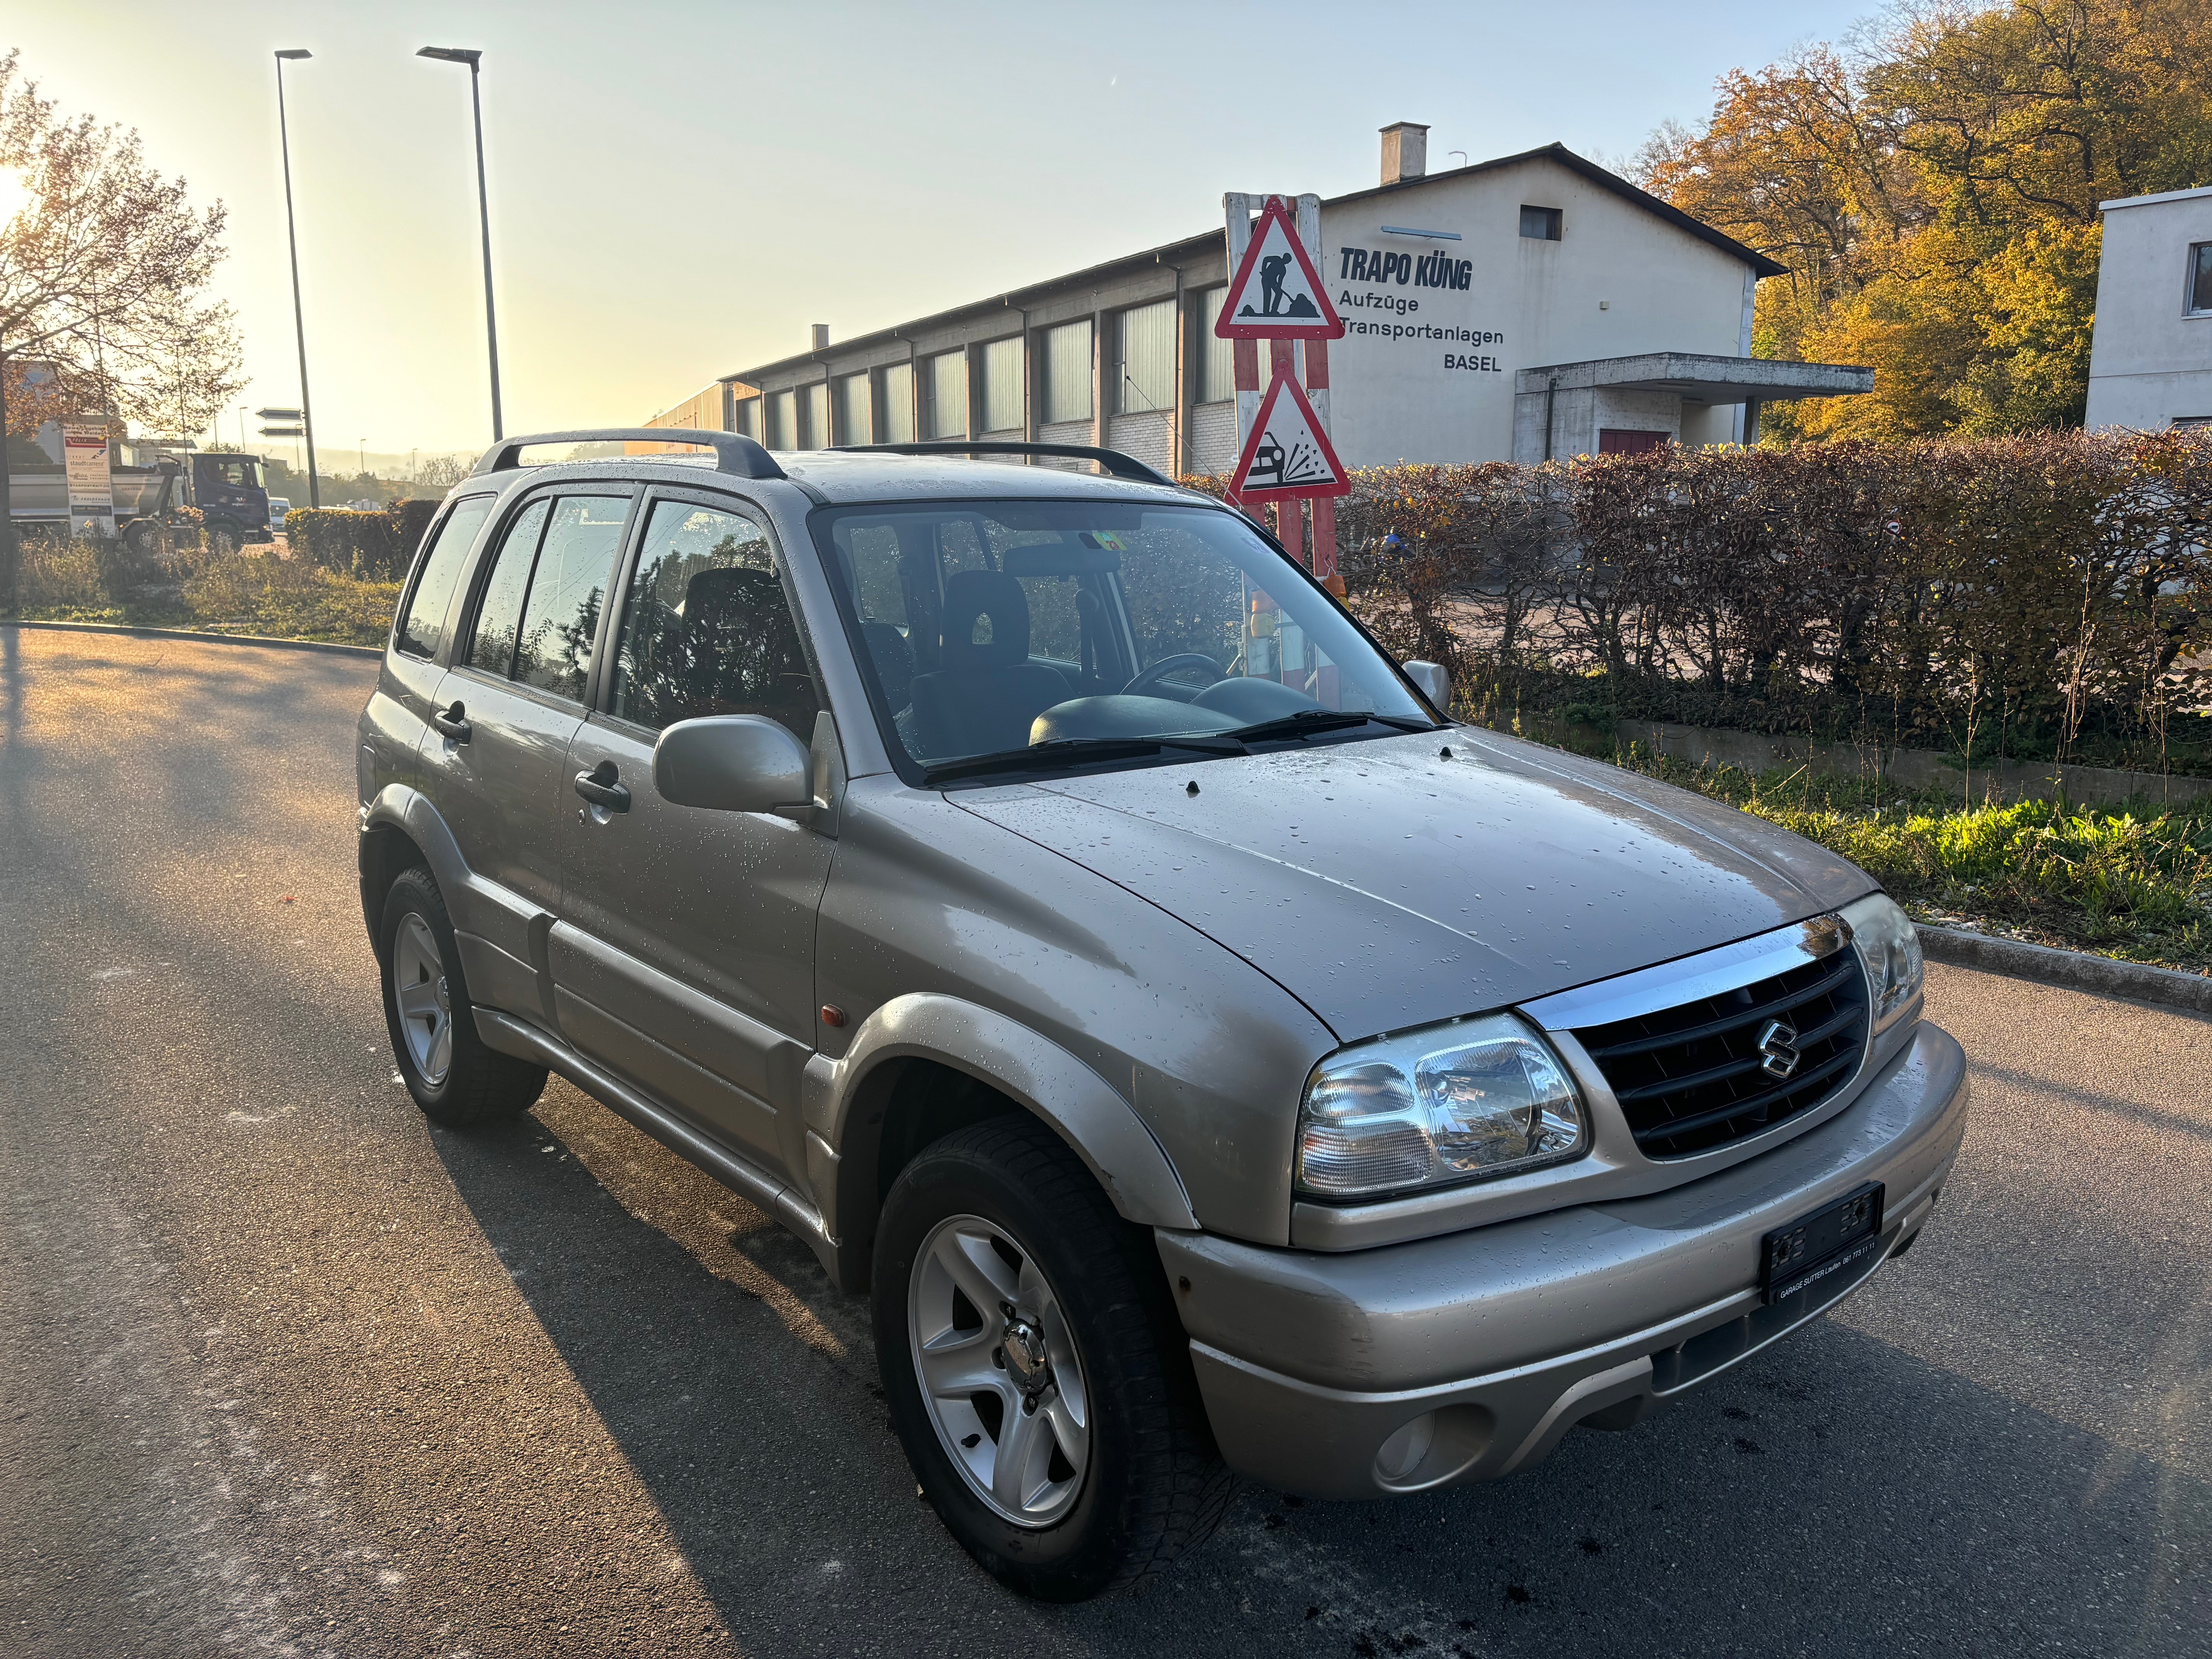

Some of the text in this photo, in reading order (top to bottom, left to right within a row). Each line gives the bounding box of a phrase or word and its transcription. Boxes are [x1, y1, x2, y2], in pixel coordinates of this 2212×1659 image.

[1341, 247, 1472, 290] TRAPO KÜNG
[1339, 290, 1418, 315] Aufzüge
[1339, 317, 1503, 347] Transportanlagen
[1444, 354, 1501, 372] BASEL
[1780, 1281, 1803, 1298] GARAGE
[1803, 1269, 1824, 1286] SUTTER
[1825, 1262, 1841, 1274] Laufen
[1843, 1254, 1851, 1264] 061
[1863, 1245, 1868, 1254] 11
